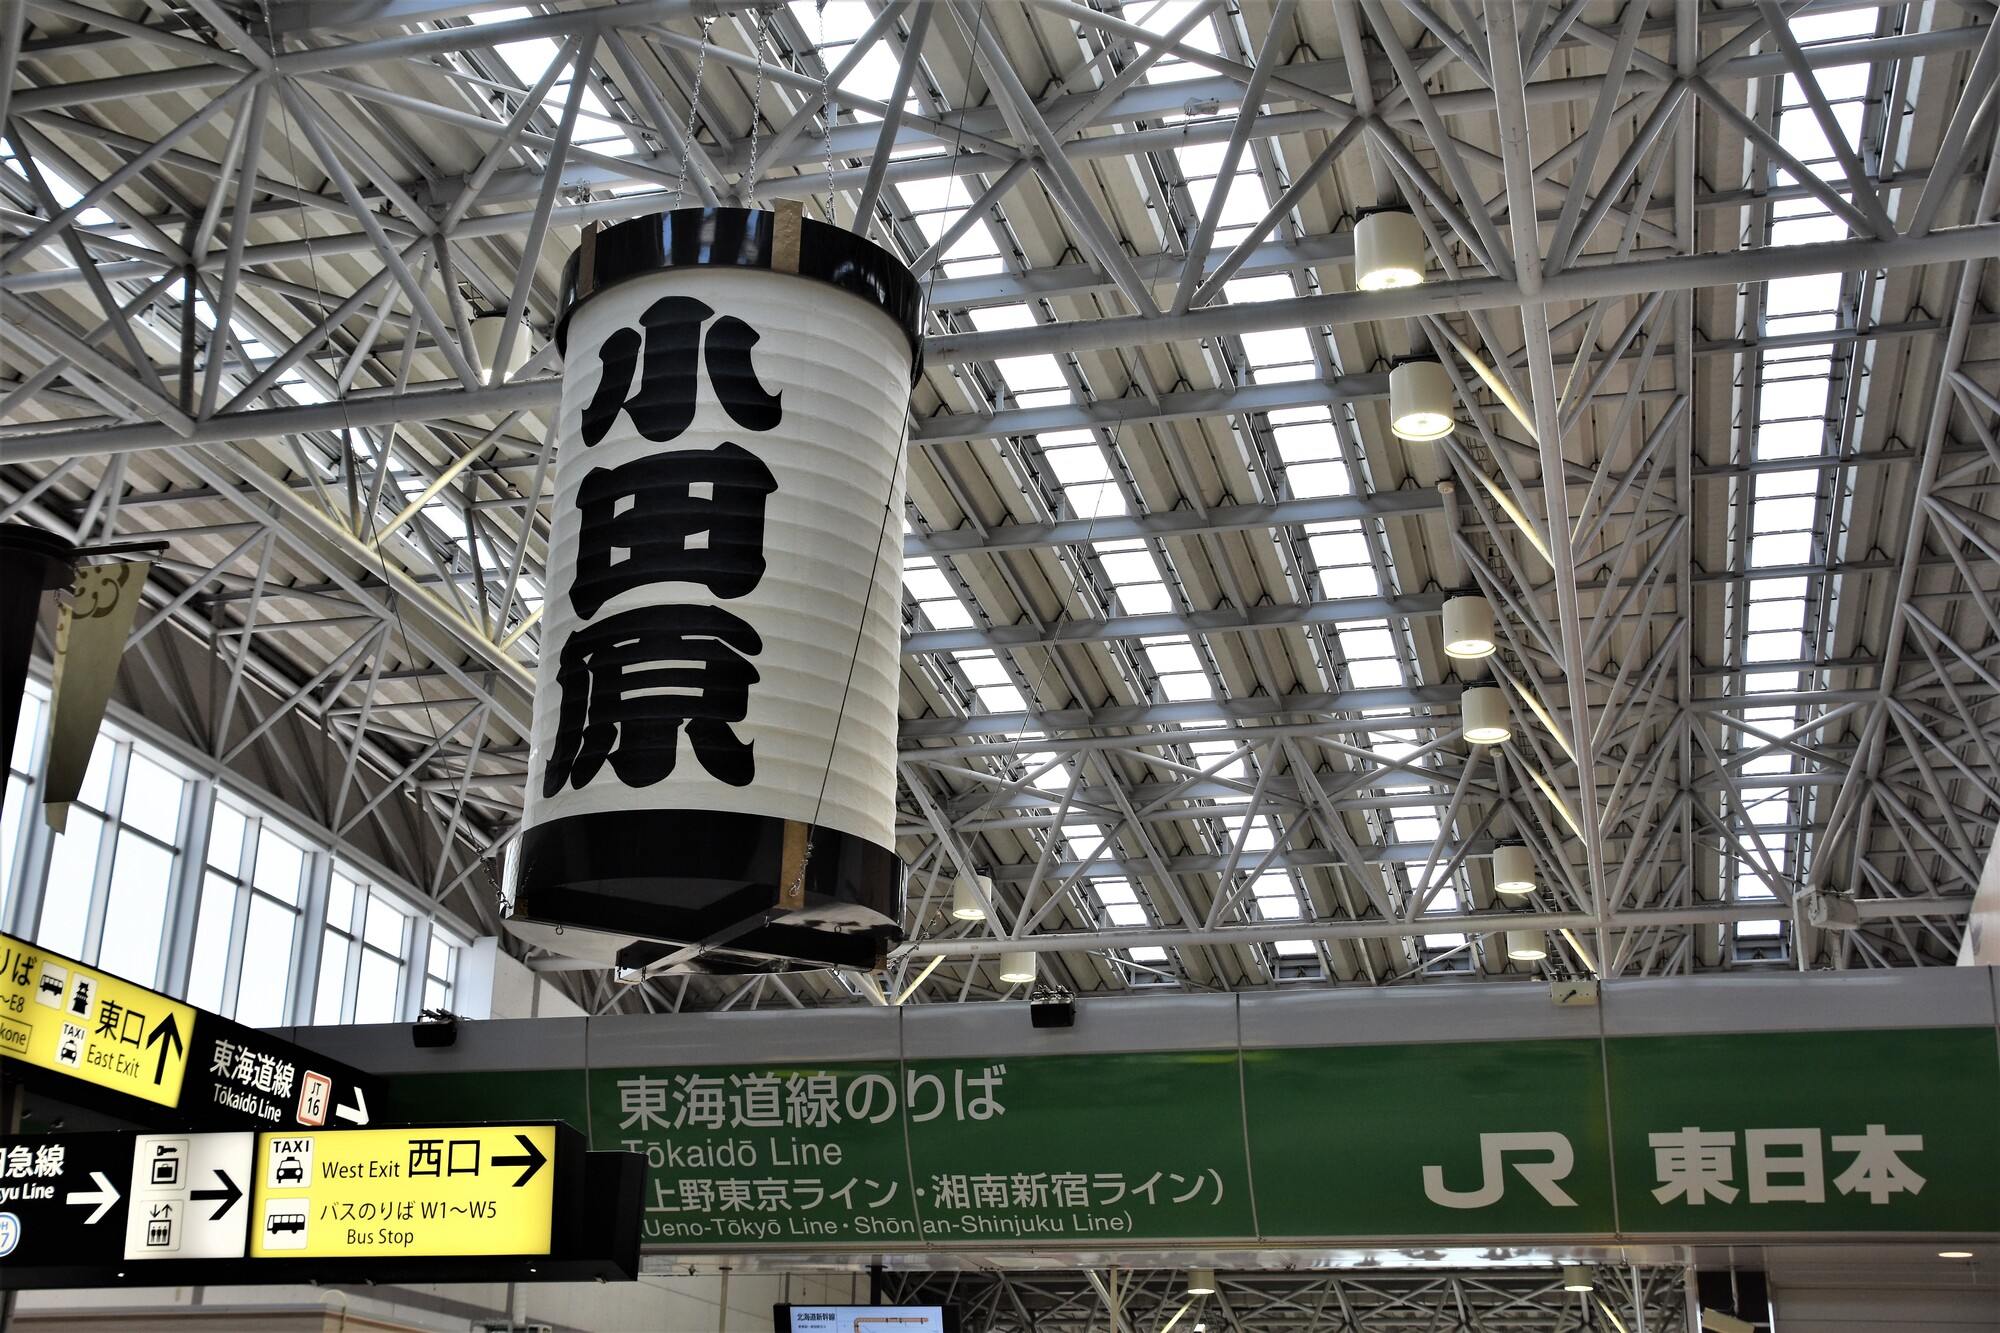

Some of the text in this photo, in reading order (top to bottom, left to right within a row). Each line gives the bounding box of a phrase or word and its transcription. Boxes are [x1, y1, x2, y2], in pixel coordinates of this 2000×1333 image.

[543, 296, 782, 798] 小田原
[64, 1023, 85, 1041] TAXI
[95, 1000, 146, 1050] 東口
[87, 1044, 140, 1078] East Exit
[209, 1039, 296, 1099] 東海道線
[213, 1083, 282, 1123] Tōkaidō Line
[311, 1082, 322, 1096] JT
[616, 1064, 1008, 1131] 東海道線のりば
[307, 1097, 320, 1116] 16
[273, 1140, 310, 1153] TAXI
[322, 1139, 481, 1179] West Exit 西口
[770, 1137, 842, 1166] Line
[1422, 1124, 1927, 1209] JR 東日本
[0, 1183, 55, 1204] yu Line
[320, 1201, 415, 1222] バスのりば
[1072, 1210, 1133, 1233] Line)
[347, 1229, 414, 1247] Bus Stop
